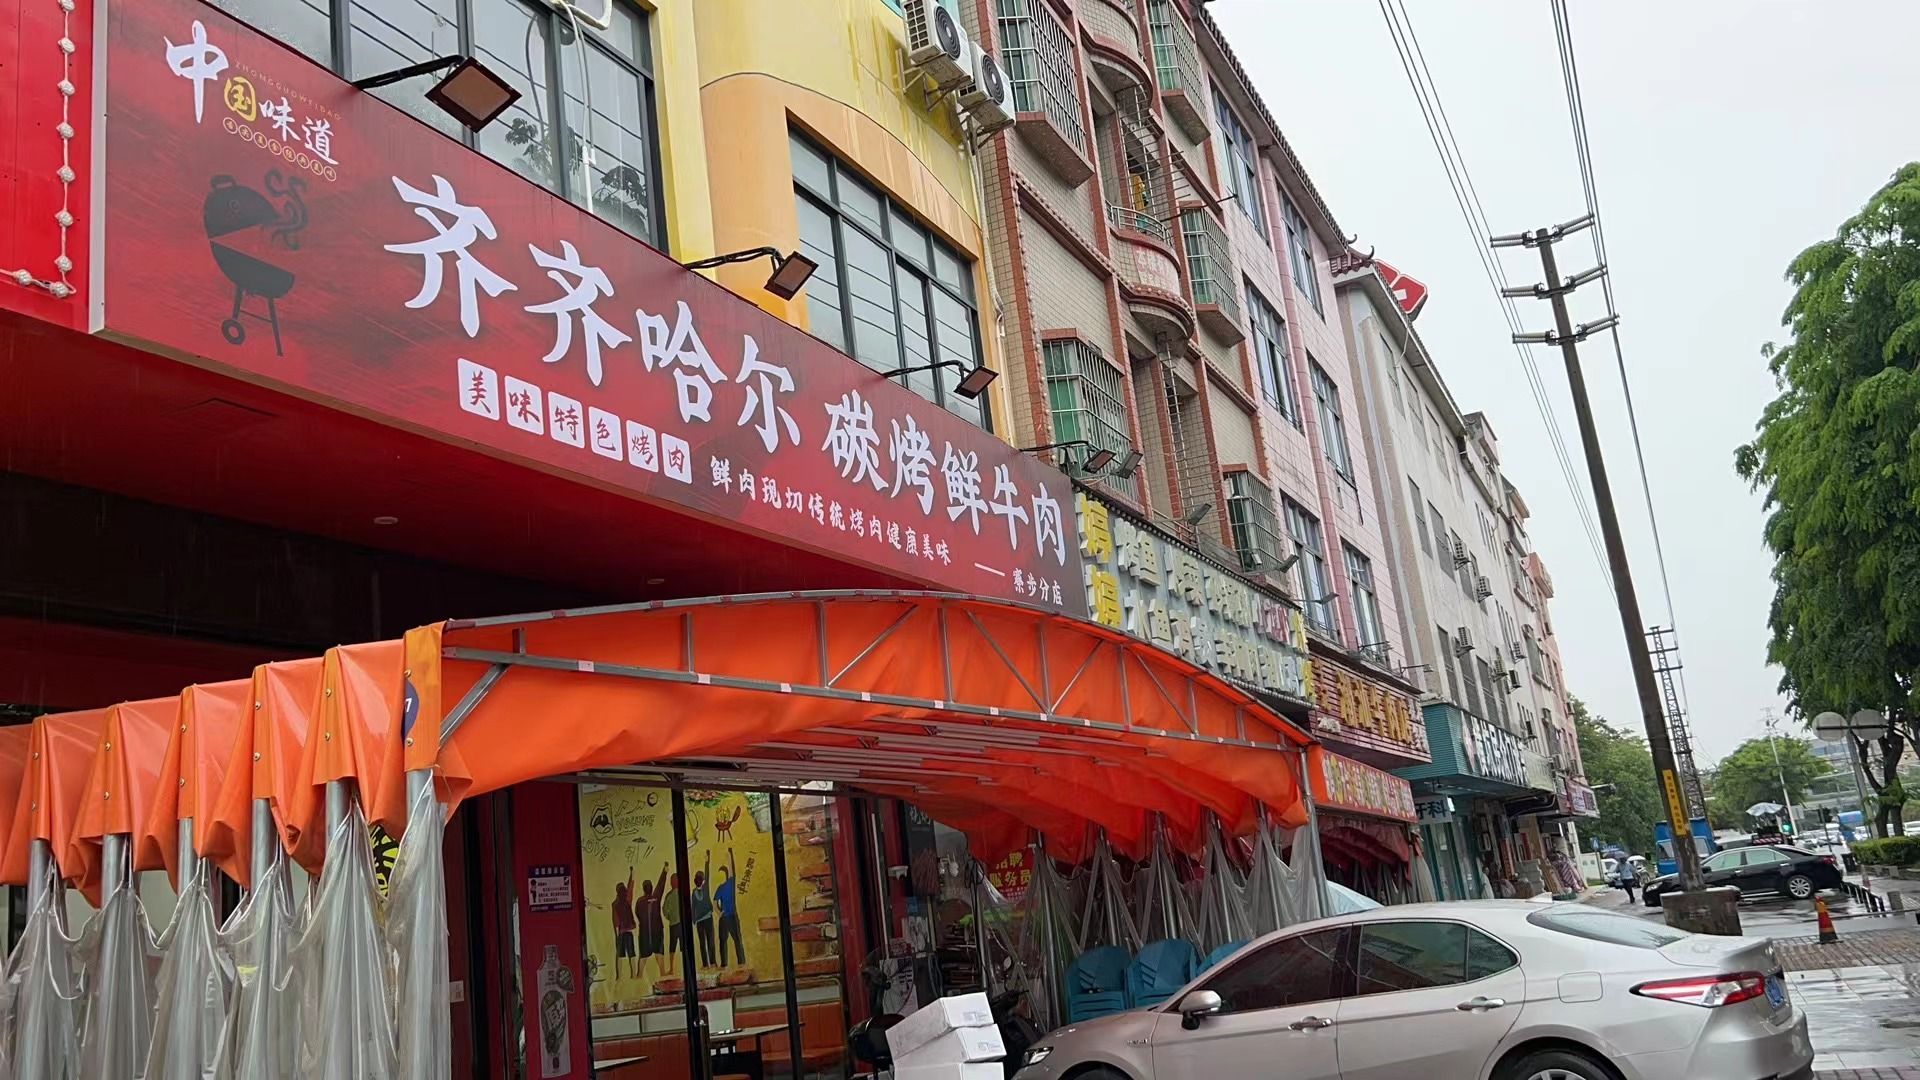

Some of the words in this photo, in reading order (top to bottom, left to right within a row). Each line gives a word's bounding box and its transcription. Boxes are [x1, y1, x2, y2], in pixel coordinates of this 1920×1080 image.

[164, 20, 340, 165] 中国味道
[384, 174, 801, 453] 齐齐哈尔
[822, 389, 1066, 566] 碳烤鲜牛肉
[467, 370, 685, 475] 美味特色烤肉
[710, 455, 951, 566] 鲜肉现切传统烤肉健康美味
